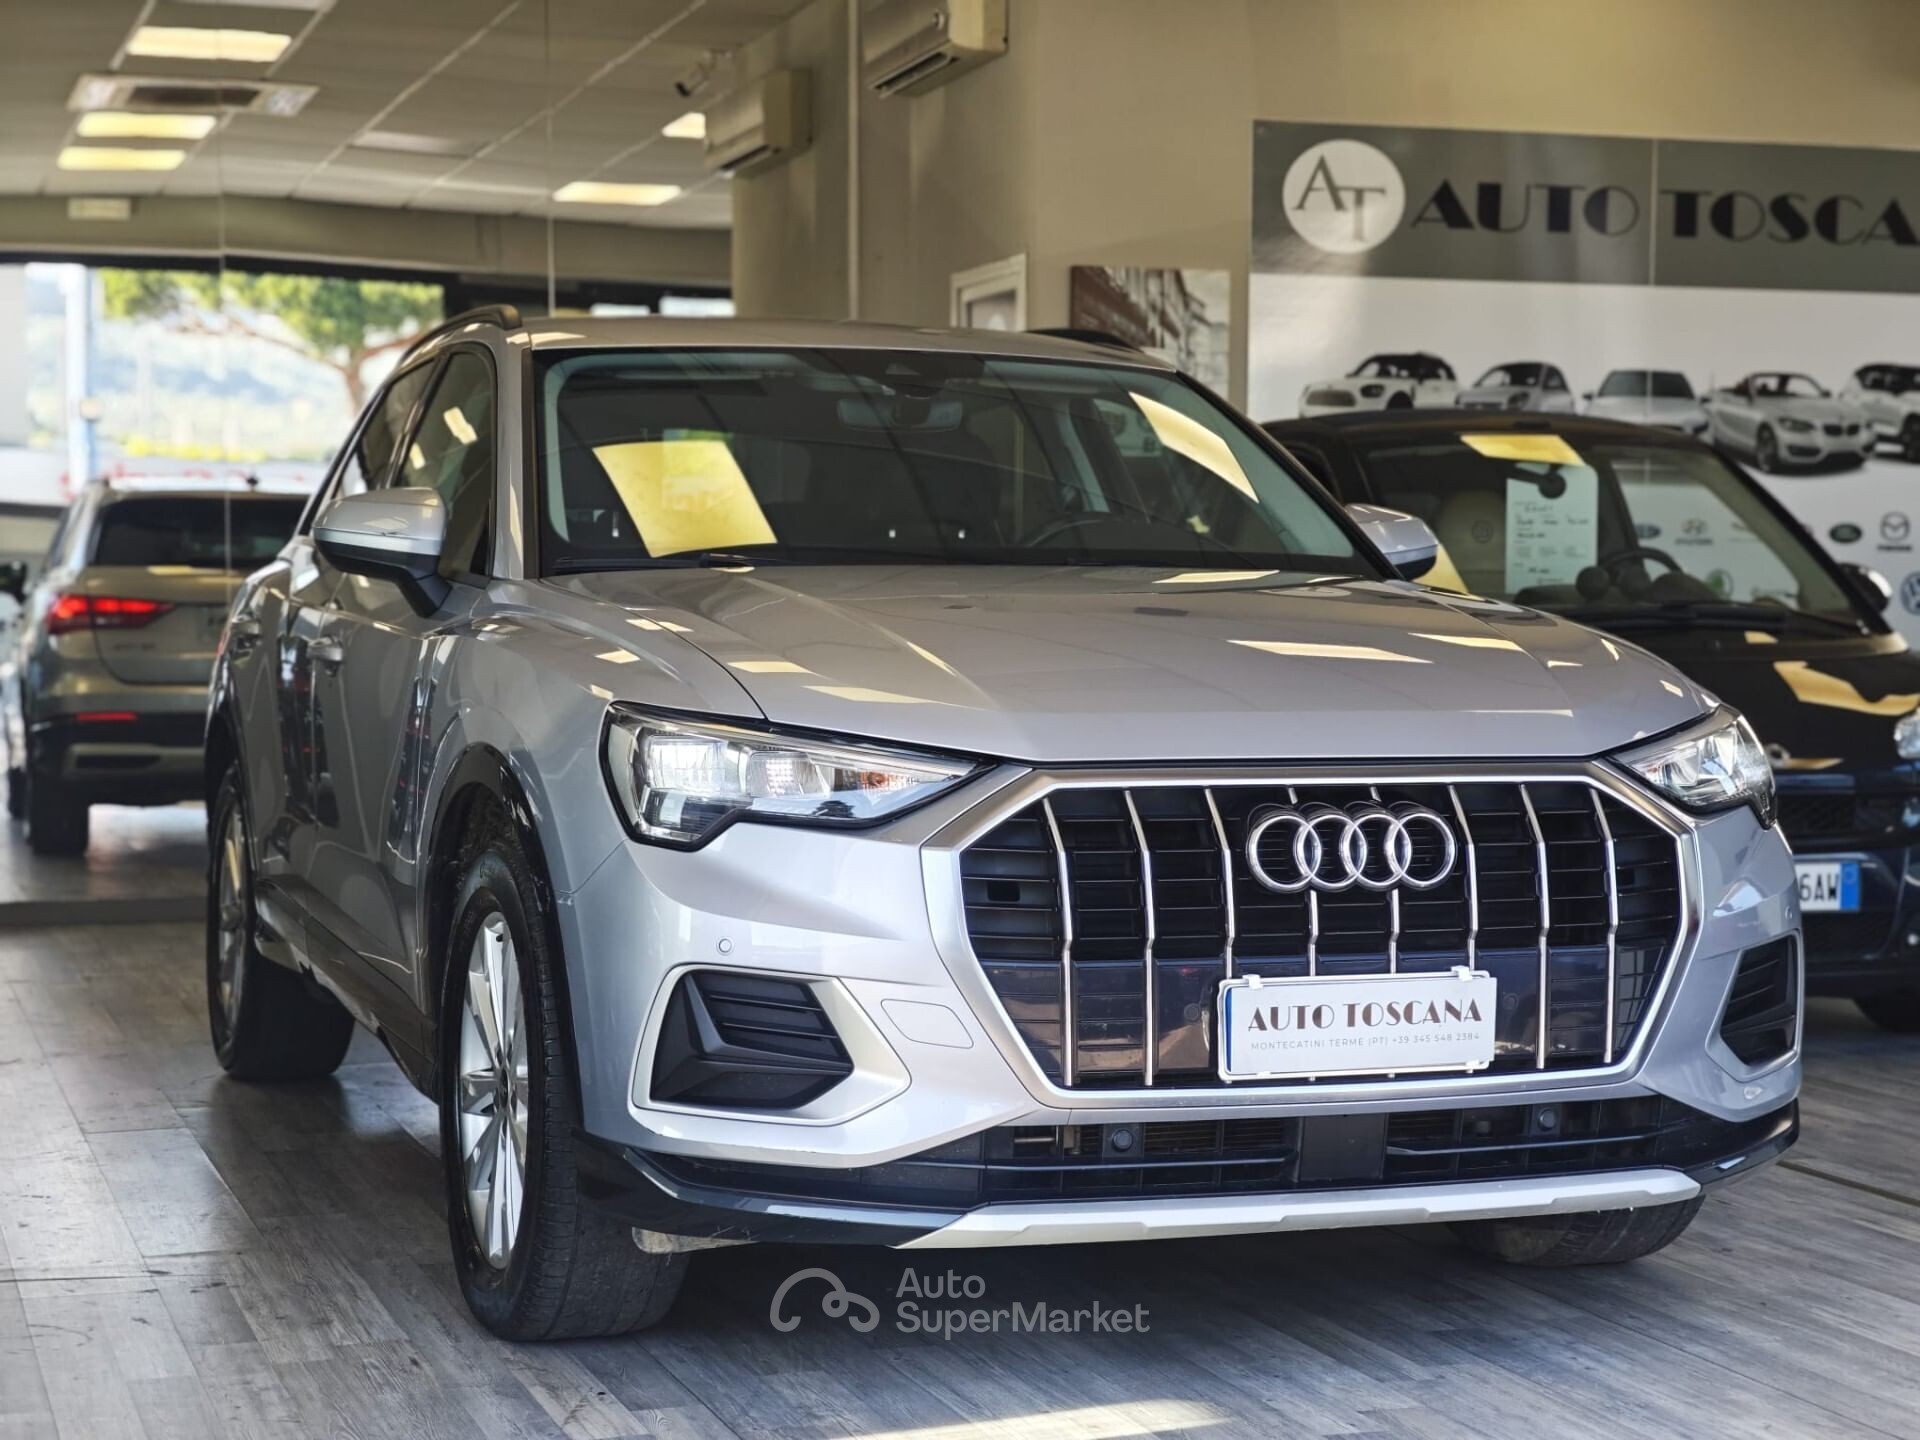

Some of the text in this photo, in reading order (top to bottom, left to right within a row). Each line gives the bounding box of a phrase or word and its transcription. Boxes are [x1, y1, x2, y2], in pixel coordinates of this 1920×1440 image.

[1410, 178, 1920, 247] AUTO TOSCA
[1248, 998, 1482, 1032] AUTO TOSCANA
[1251, 1039, 1325, 1051] MONTECATINI
[1329, 1037, 1365, 1048] TERME
